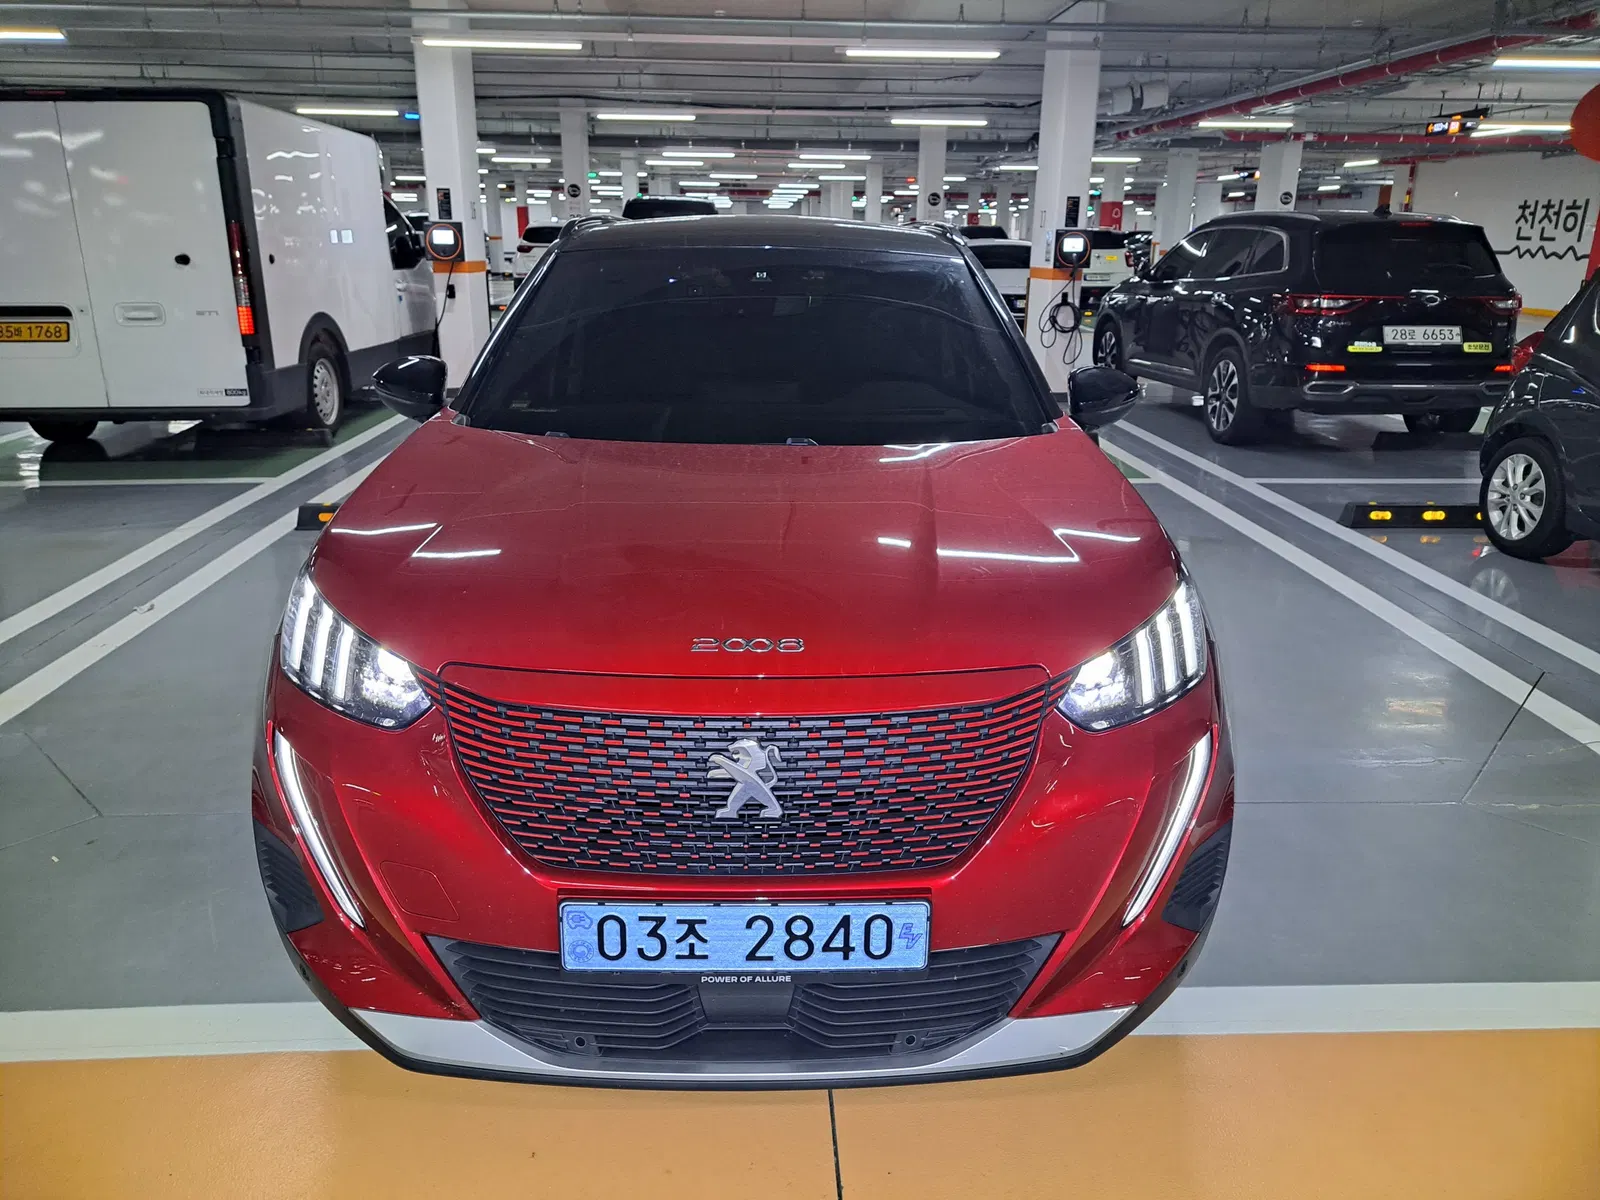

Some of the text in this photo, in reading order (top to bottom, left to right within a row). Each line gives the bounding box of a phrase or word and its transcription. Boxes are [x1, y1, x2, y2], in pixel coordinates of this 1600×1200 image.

[1515, 198, 1590, 243] 천천히
[27, 325, 62, 339] 1768
[1391, 328, 1455, 341] 28로 6653
[690, 638, 805, 653] 2008
[597, 914, 709, 962] 03조
[745, 913, 893, 962] 2840
[898, 922, 923, 950] EV
[701, 975, 792, 983] POWER OF ALLURE
